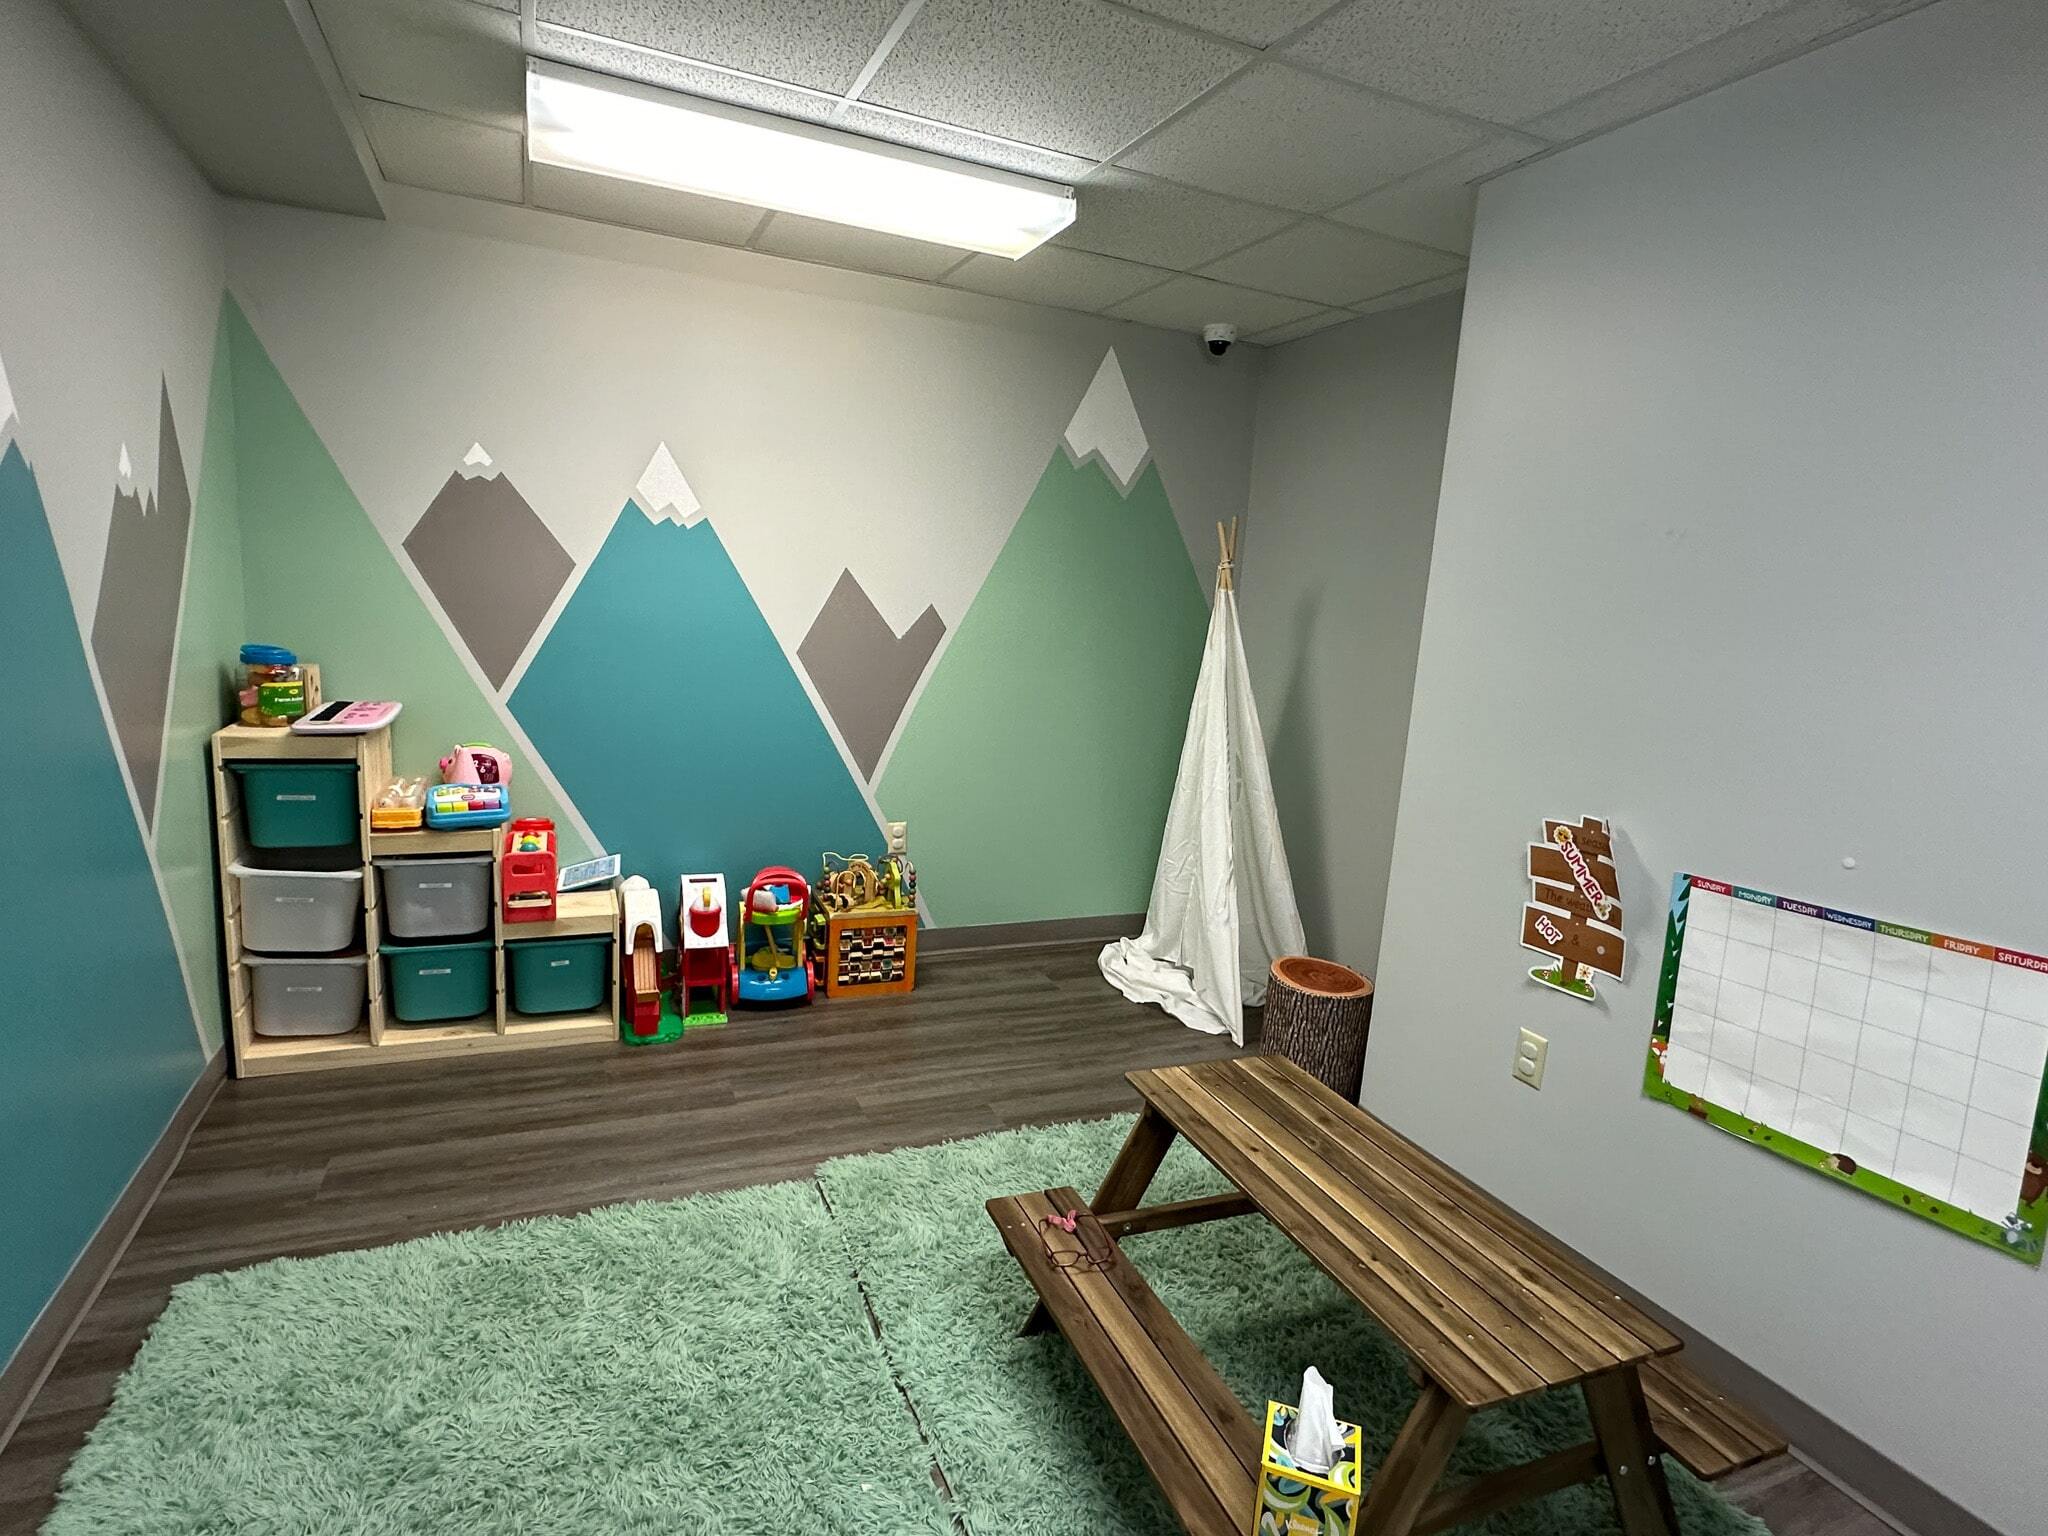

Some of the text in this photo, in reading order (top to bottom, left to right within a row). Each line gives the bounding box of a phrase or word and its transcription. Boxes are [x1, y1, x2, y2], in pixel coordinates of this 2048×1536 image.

[1544, 887, 1563, 902] The
[1561, 841, 1603, 905] SUMMER
[1537, 917, 1579, 945] HOT &
[1697, 880, 2048, 971] SUNDAY MONDAY TUESDAY WEDNESDAY THURSDAY FRIDAY SATURDA
